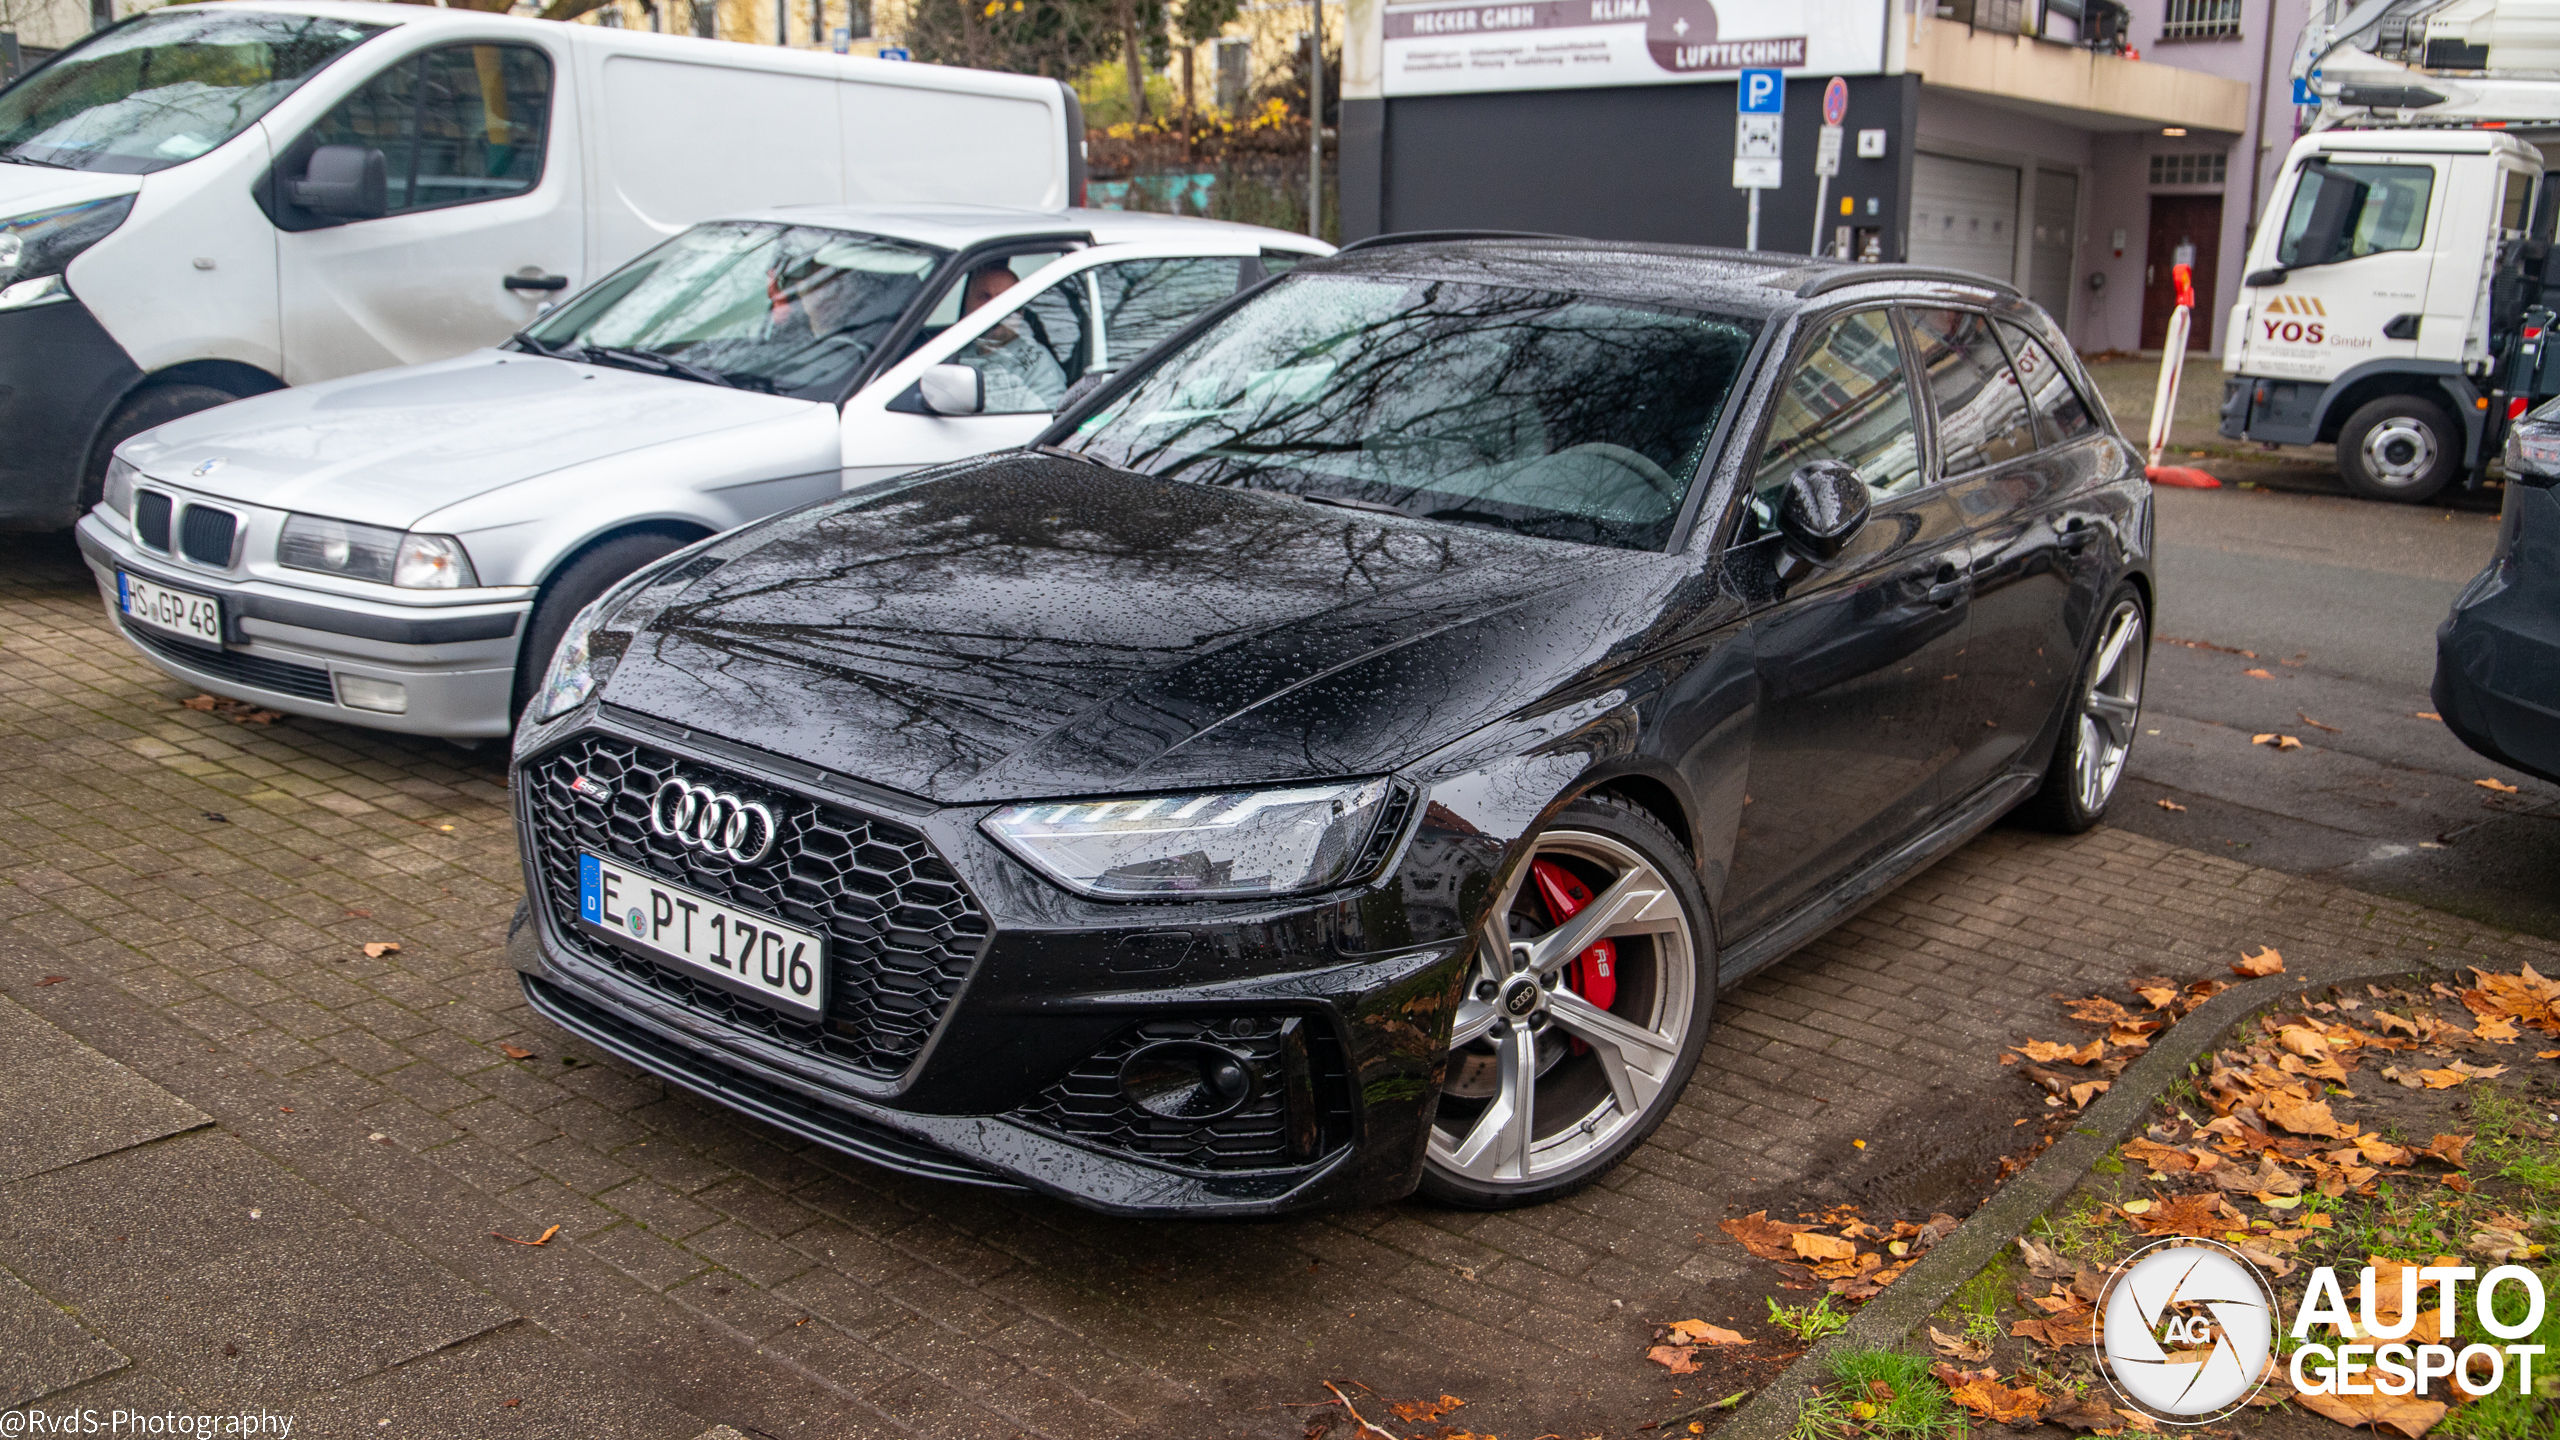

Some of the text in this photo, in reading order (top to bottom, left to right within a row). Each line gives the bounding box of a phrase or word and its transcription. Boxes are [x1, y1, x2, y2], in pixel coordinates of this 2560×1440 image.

[1482, 6, 1535, 29] GMBH
[1591, 0, 1651, 20] KLIMA
[1675, 40, 1803, 68] LUFTTECHNIK
[1749, 74, 1774, 109] P
[2263, 318, 2372, 349] YOS GmbH
[129, 580, 148, 616] HS
[159, 591, 184, 628] GP
[190, 600, 217, 637] 48
[587, 869, 813, 996] D E PT 1706
[1595, 949, 1610, 977] RS
